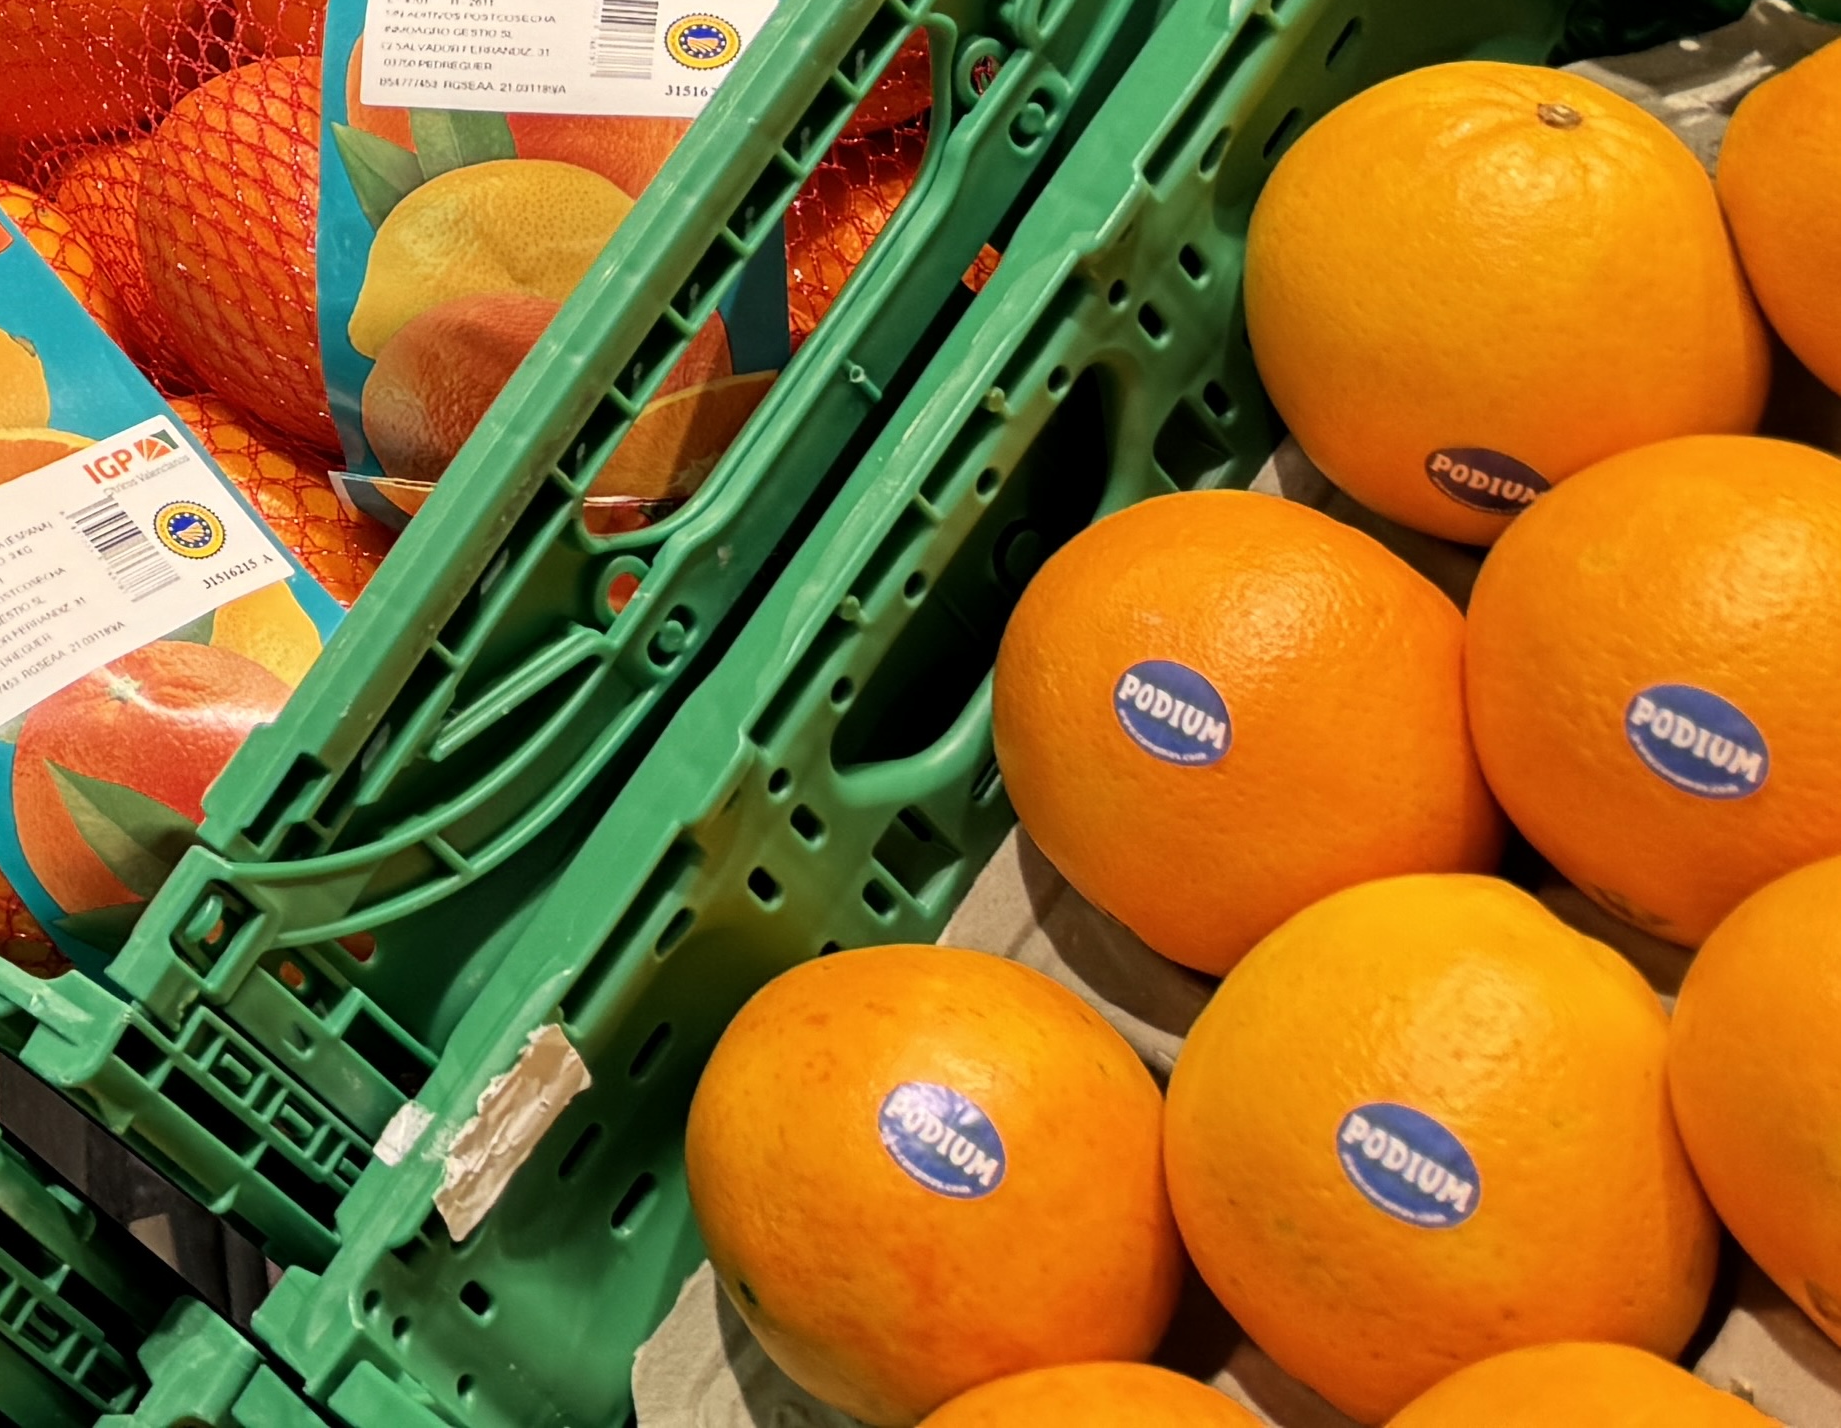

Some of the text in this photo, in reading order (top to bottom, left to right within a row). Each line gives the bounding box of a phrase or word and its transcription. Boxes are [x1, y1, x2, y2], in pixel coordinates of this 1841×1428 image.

[82, 449, 133, 484] IGP
[135, 454, 190, 483] Valencianos
[1430, 453, 1536, 503] PODIUM
[202, 554, 274, 589] 31516215 A
[1118, 673, 1226, 749] PODIUM
[1629, 695, 1763, 783] PODIUM
[884, 1094, 999, 1186] PODIUM
[1342, 1113, 1474, 1213] PODIUM
